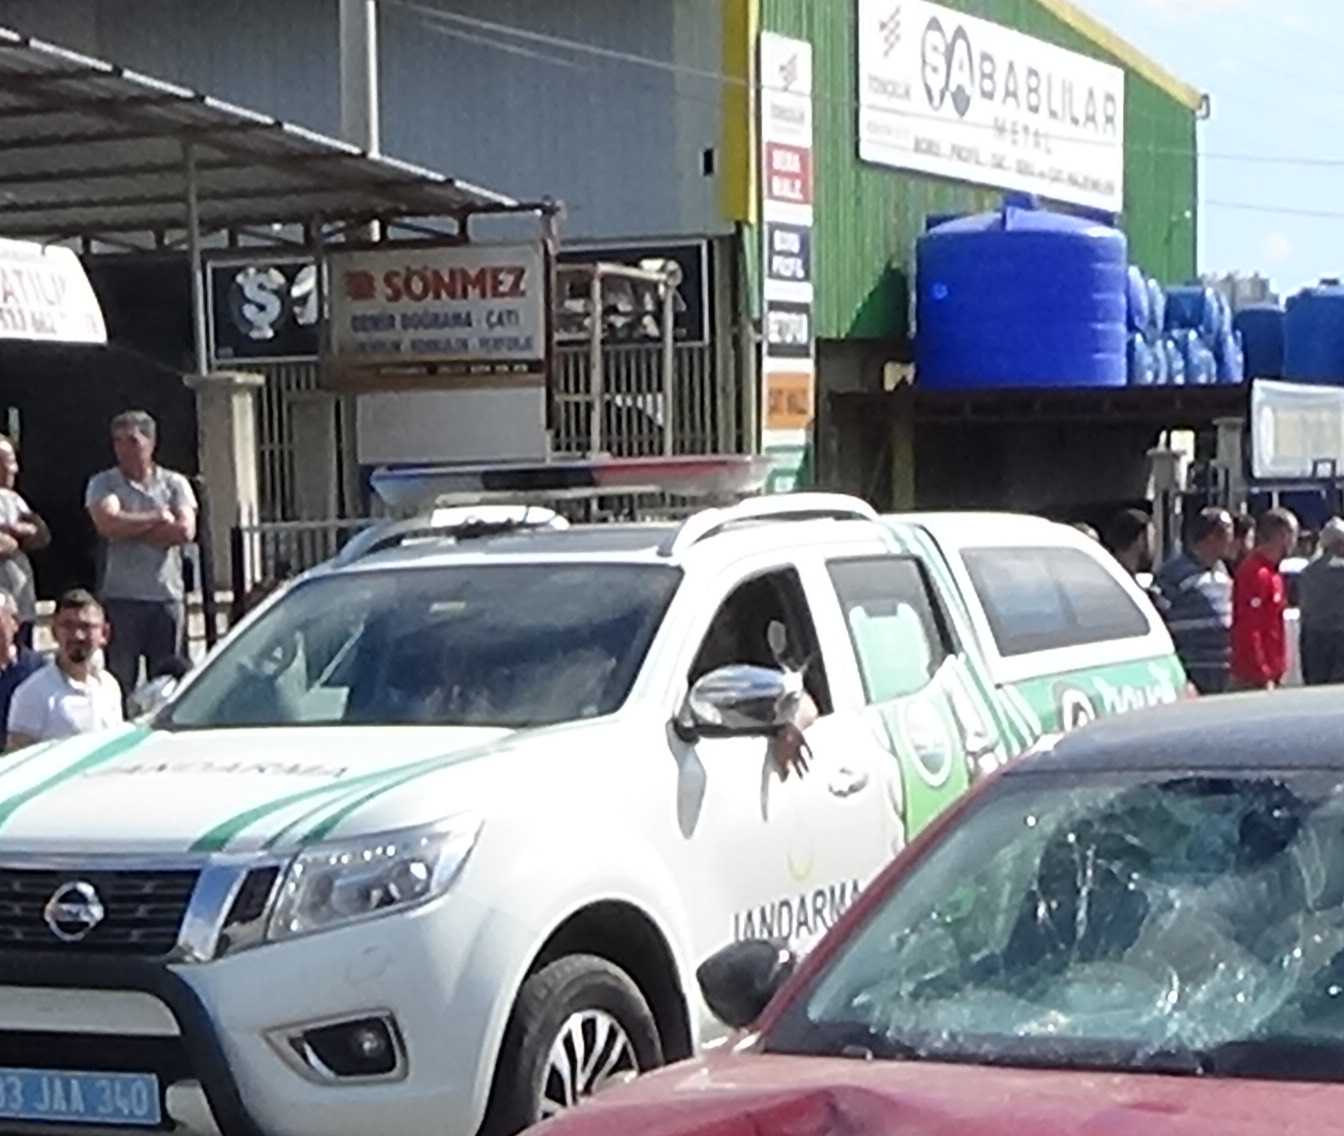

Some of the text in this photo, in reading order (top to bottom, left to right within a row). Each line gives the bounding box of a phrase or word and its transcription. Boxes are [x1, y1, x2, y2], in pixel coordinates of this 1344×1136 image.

[383, 266, 526, 302] SÖNMEZ
[35, 1076, 85, 1113] JAA
[97, 1079, 149, 1117] 340
